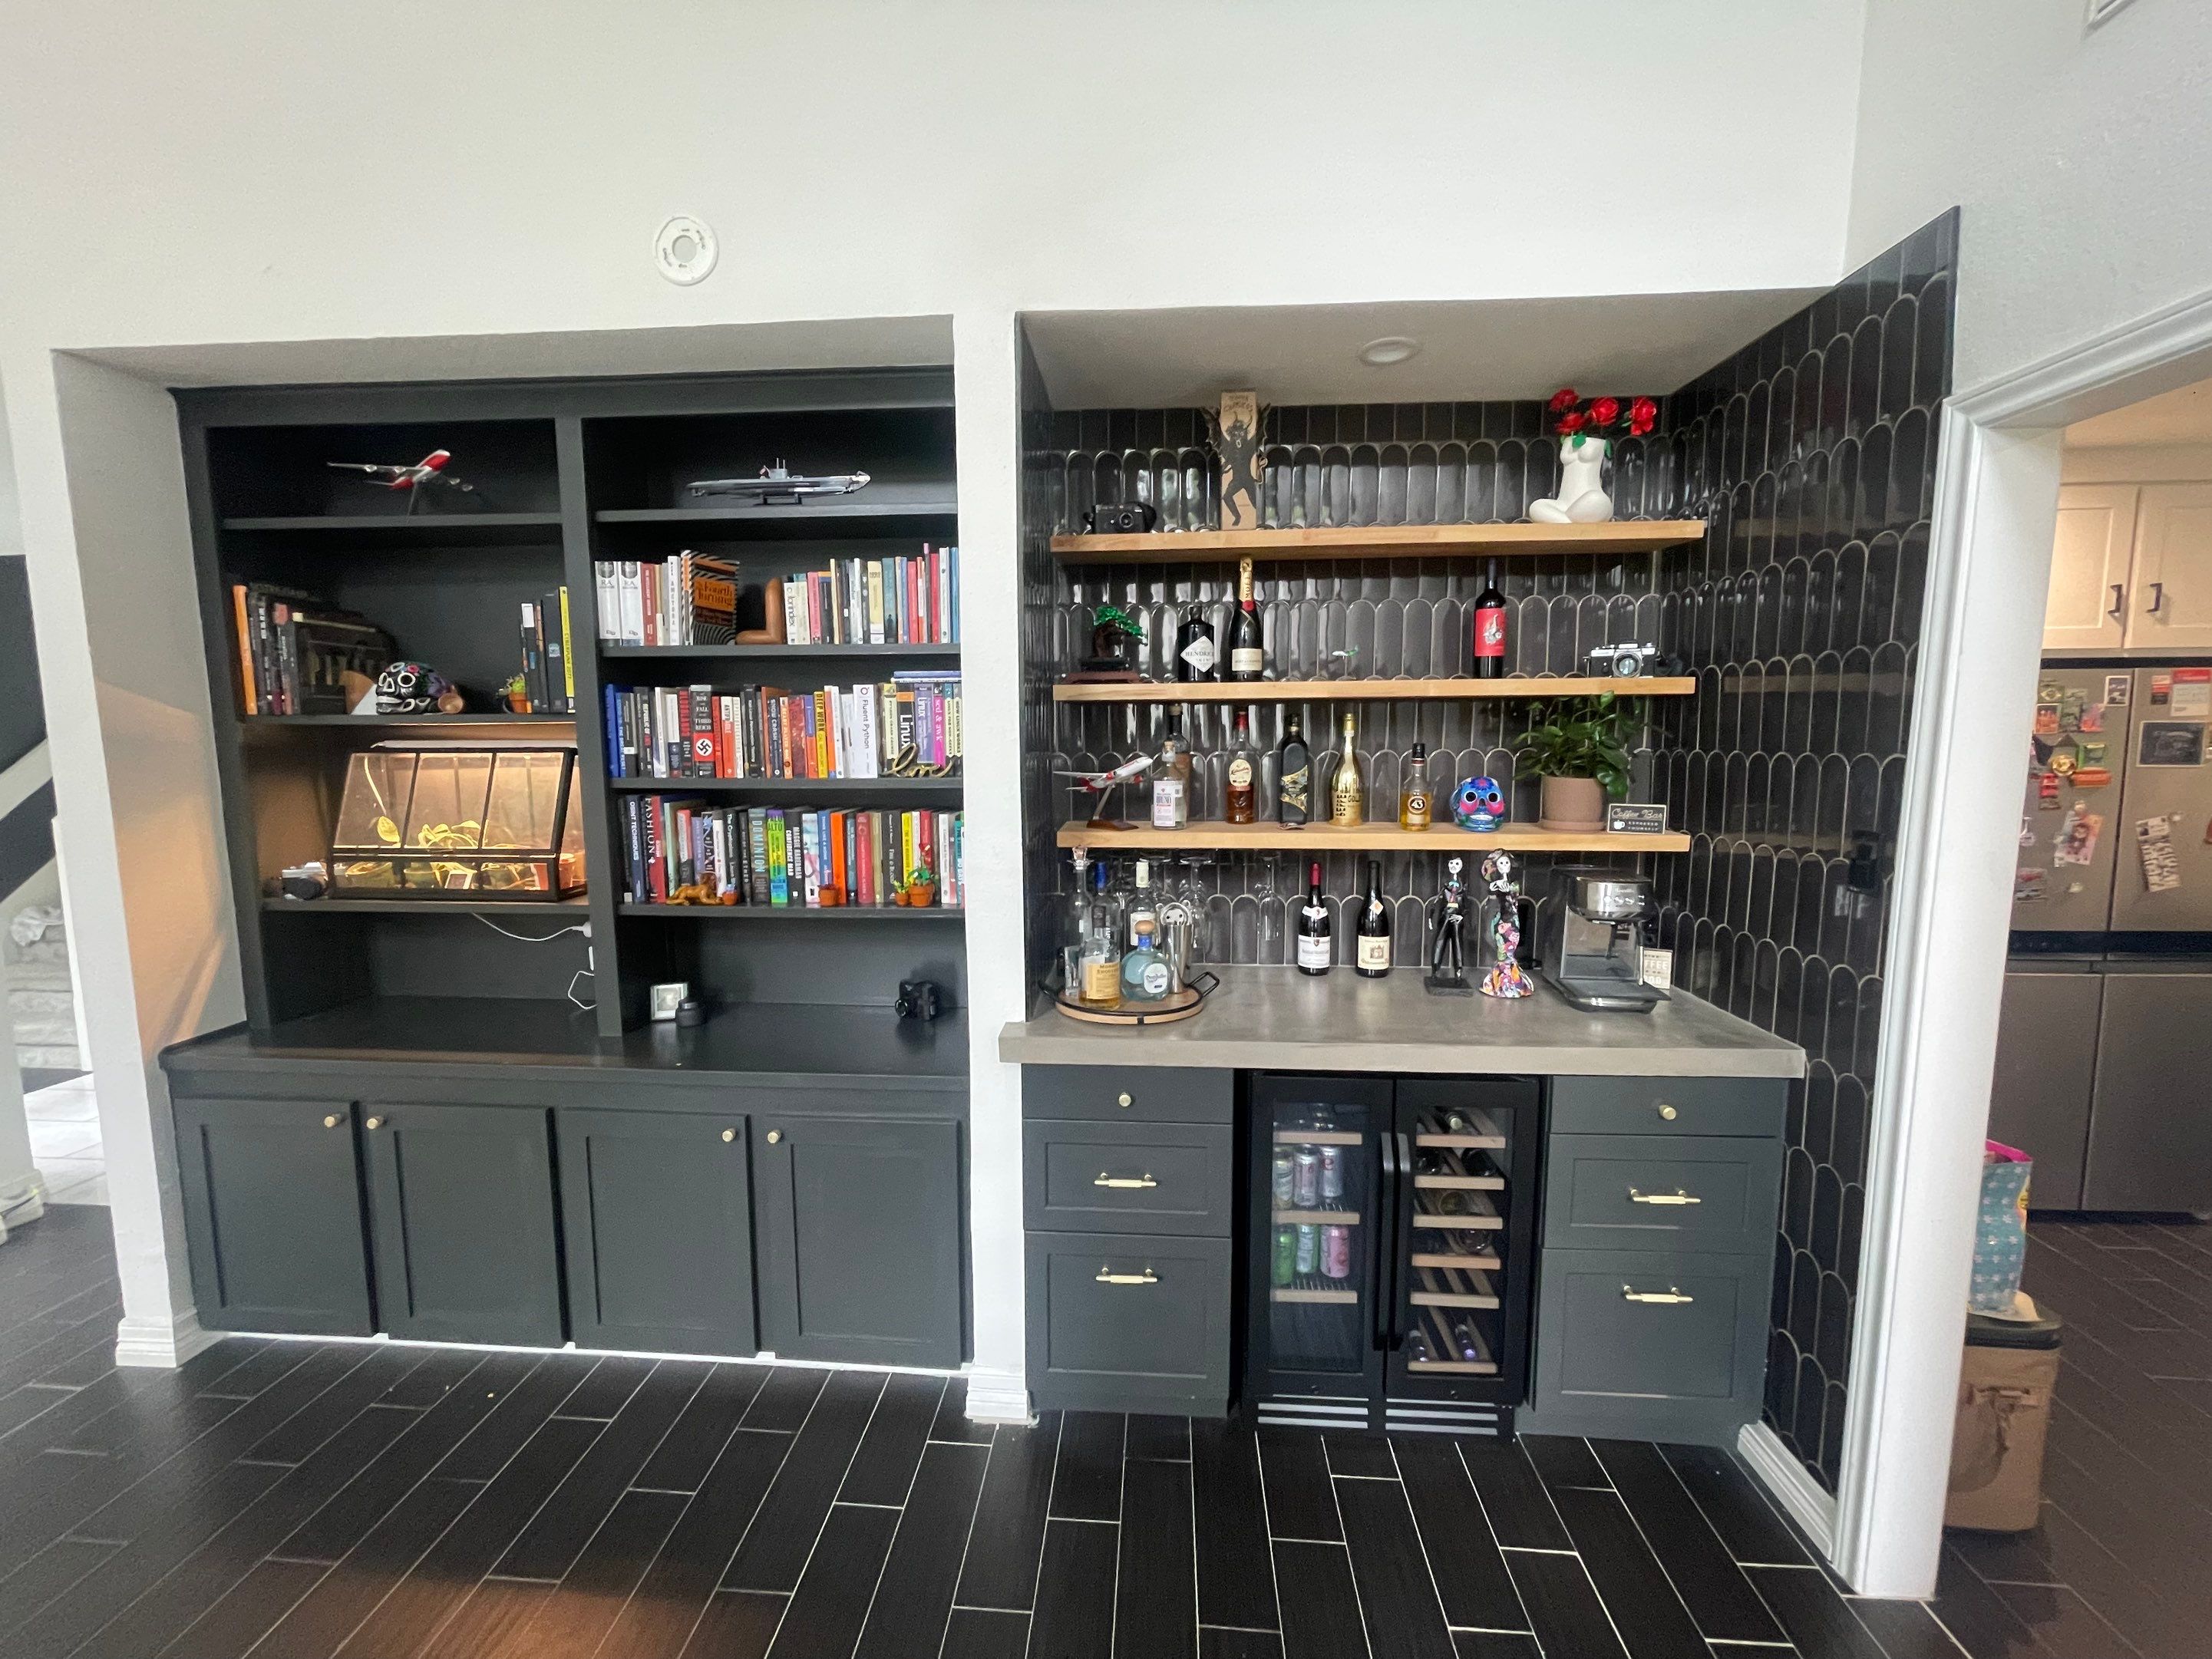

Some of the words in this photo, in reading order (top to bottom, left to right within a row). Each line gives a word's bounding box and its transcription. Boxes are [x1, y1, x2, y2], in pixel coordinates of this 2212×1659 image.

[698, 589, 732, 605] Turning
[705, 582, 732, 595] Fourth
[917, 697, 927, 717] Linux
[900, 714, 913, 749] Linux
[1411, 799, 1425, 809] 43
[1612, 808, 1639, 819] Coffee
[1642, 810, 1662, 819] Bar
[645, 798, 655, 853] FASHION
[752, 820, 765, 872] DOMINION
